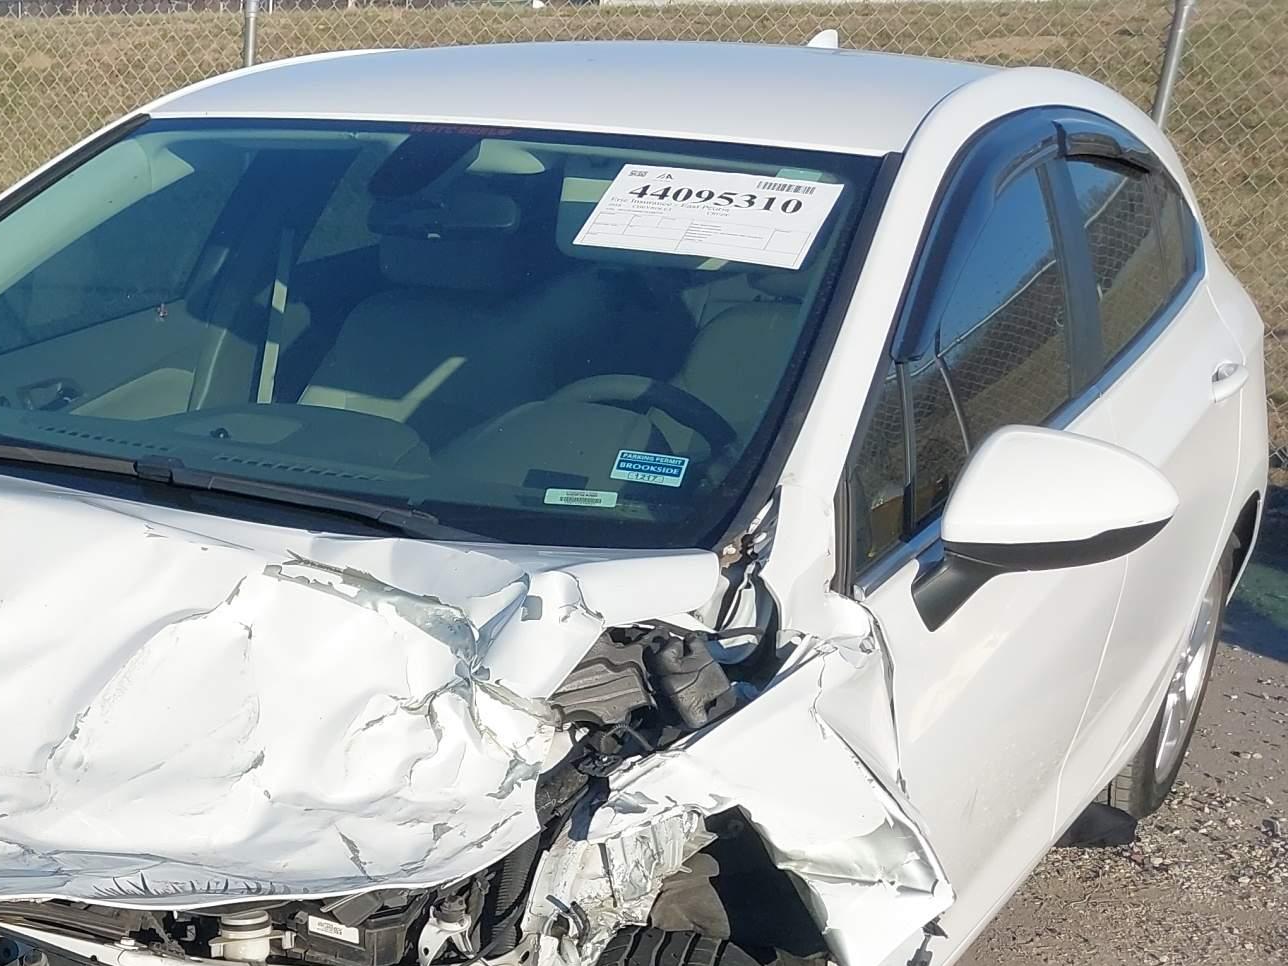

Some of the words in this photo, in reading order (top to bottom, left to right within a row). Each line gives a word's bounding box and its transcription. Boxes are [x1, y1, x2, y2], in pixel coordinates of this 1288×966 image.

[628, 184, 803, 214] 44095310
[622, 453, 655, 462] PARKING
[655, 456, 683, 465] PERMIT
[619, 461, 680, 475] BROOKSIDE
